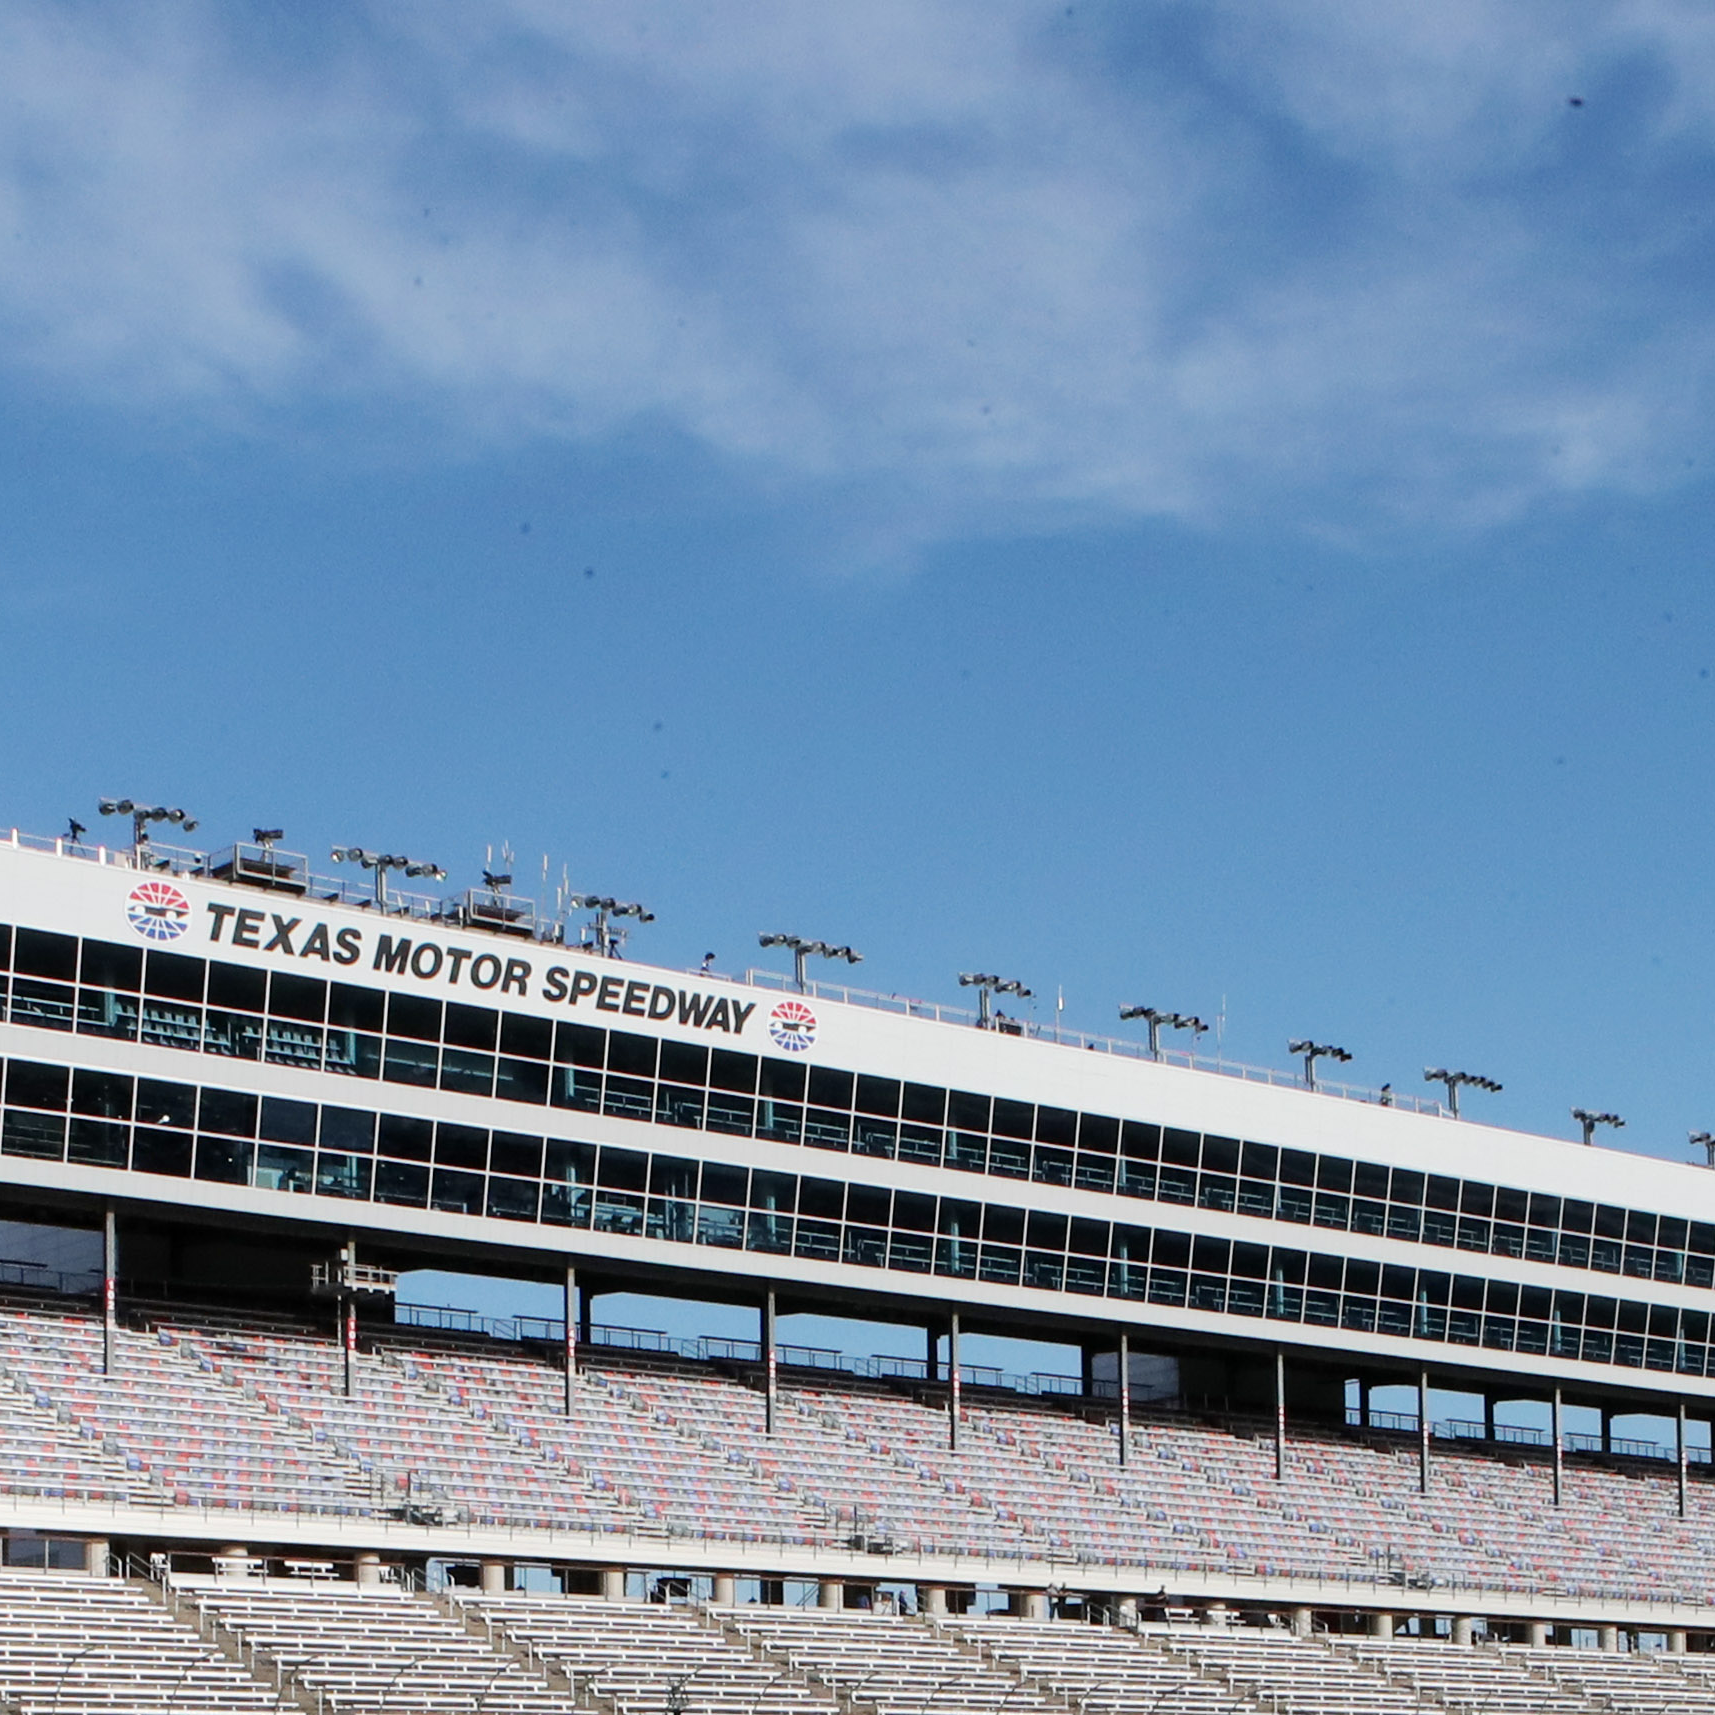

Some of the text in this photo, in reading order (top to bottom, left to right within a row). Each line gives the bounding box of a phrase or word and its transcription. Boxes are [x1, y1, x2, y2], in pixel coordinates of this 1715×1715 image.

[207, 902, 757, 1035] TEXAS MOTOR SPEEDWAY
[348, 1319, 356, 1349] 101
